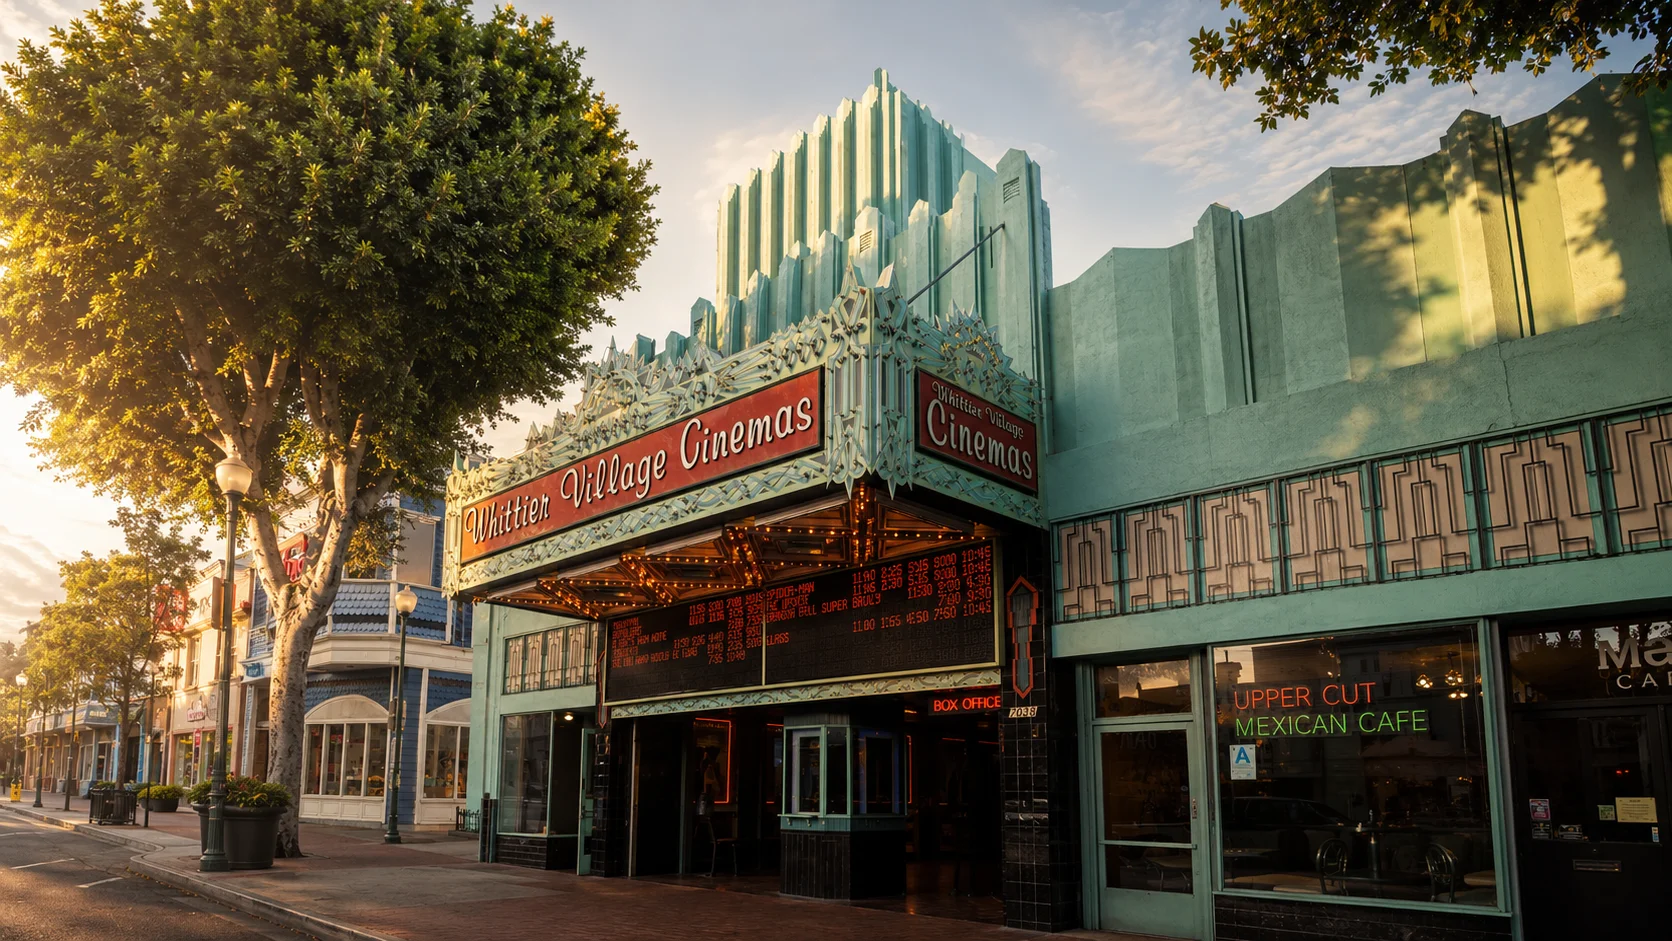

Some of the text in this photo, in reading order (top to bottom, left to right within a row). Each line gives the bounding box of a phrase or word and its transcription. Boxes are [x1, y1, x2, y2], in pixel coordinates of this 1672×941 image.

[931, 381, 982, 419] Whittier
[927, 399, 1033, 480] Cinemas
[464, 396, 813, 544] Whittier Village Cinemas
[822, 599, 849, 614] SUPER
[933, 695, 1001, 712] BOX OFFICE
[1234, 682, 1376, 710] UPPER CUT
[1010, 706, 1037, 717] 7038
[1235, 709, 1428, 737] MEXICAN CAFE
[1235, 746, 1251, 764] A
